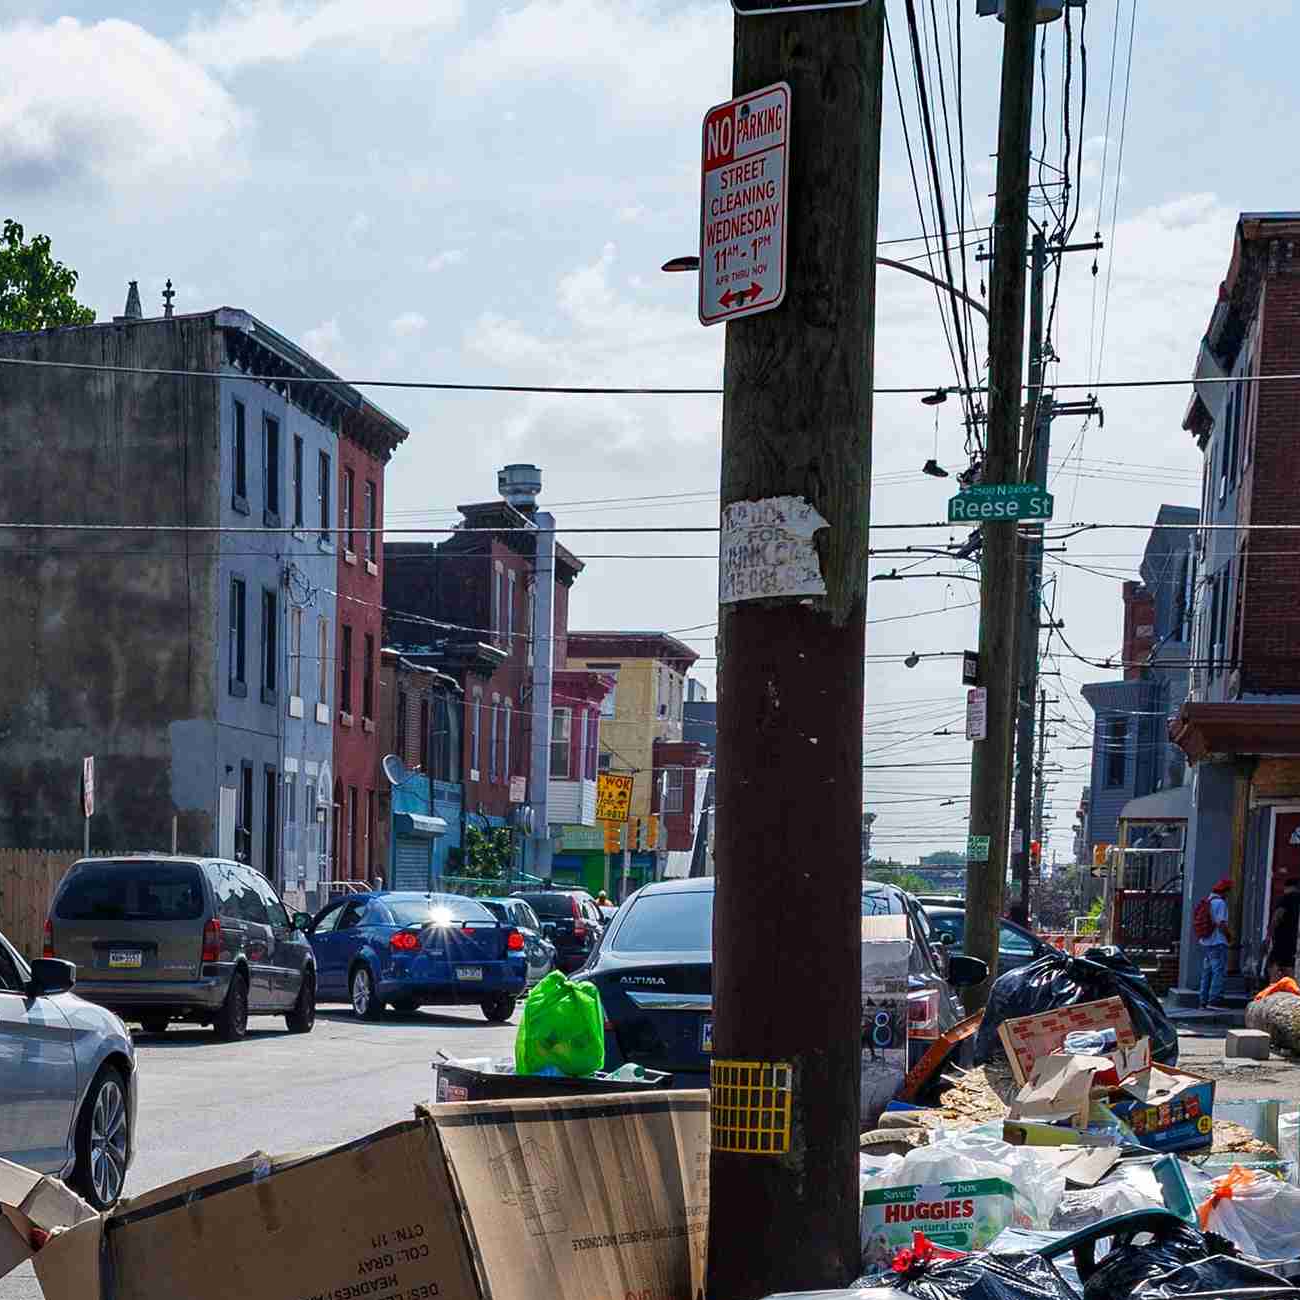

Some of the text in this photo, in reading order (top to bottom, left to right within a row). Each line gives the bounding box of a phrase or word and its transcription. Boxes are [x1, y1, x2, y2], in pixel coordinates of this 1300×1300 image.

[707, 104, 782, 160] NO PARKING
[721, 158, 766, 189] STREET
[711, 180, 775, 217] CLEANING
[706, 203, 779, 247] WEDNESDAY
[997, 485, 1006, 495] N
[952, 497, 1050, 518] Reese St
[620, 976, 666, 985] ALTIMA
[884, 1199, 975, 1224] HUGGIES
[394, 1224, 424, 1242] CTN:
[910, 1221, 975, 1233] natural care
[358, 1244, 429, 1275] COL: GRAY
[407, 1282, 439, 1300] DES:
